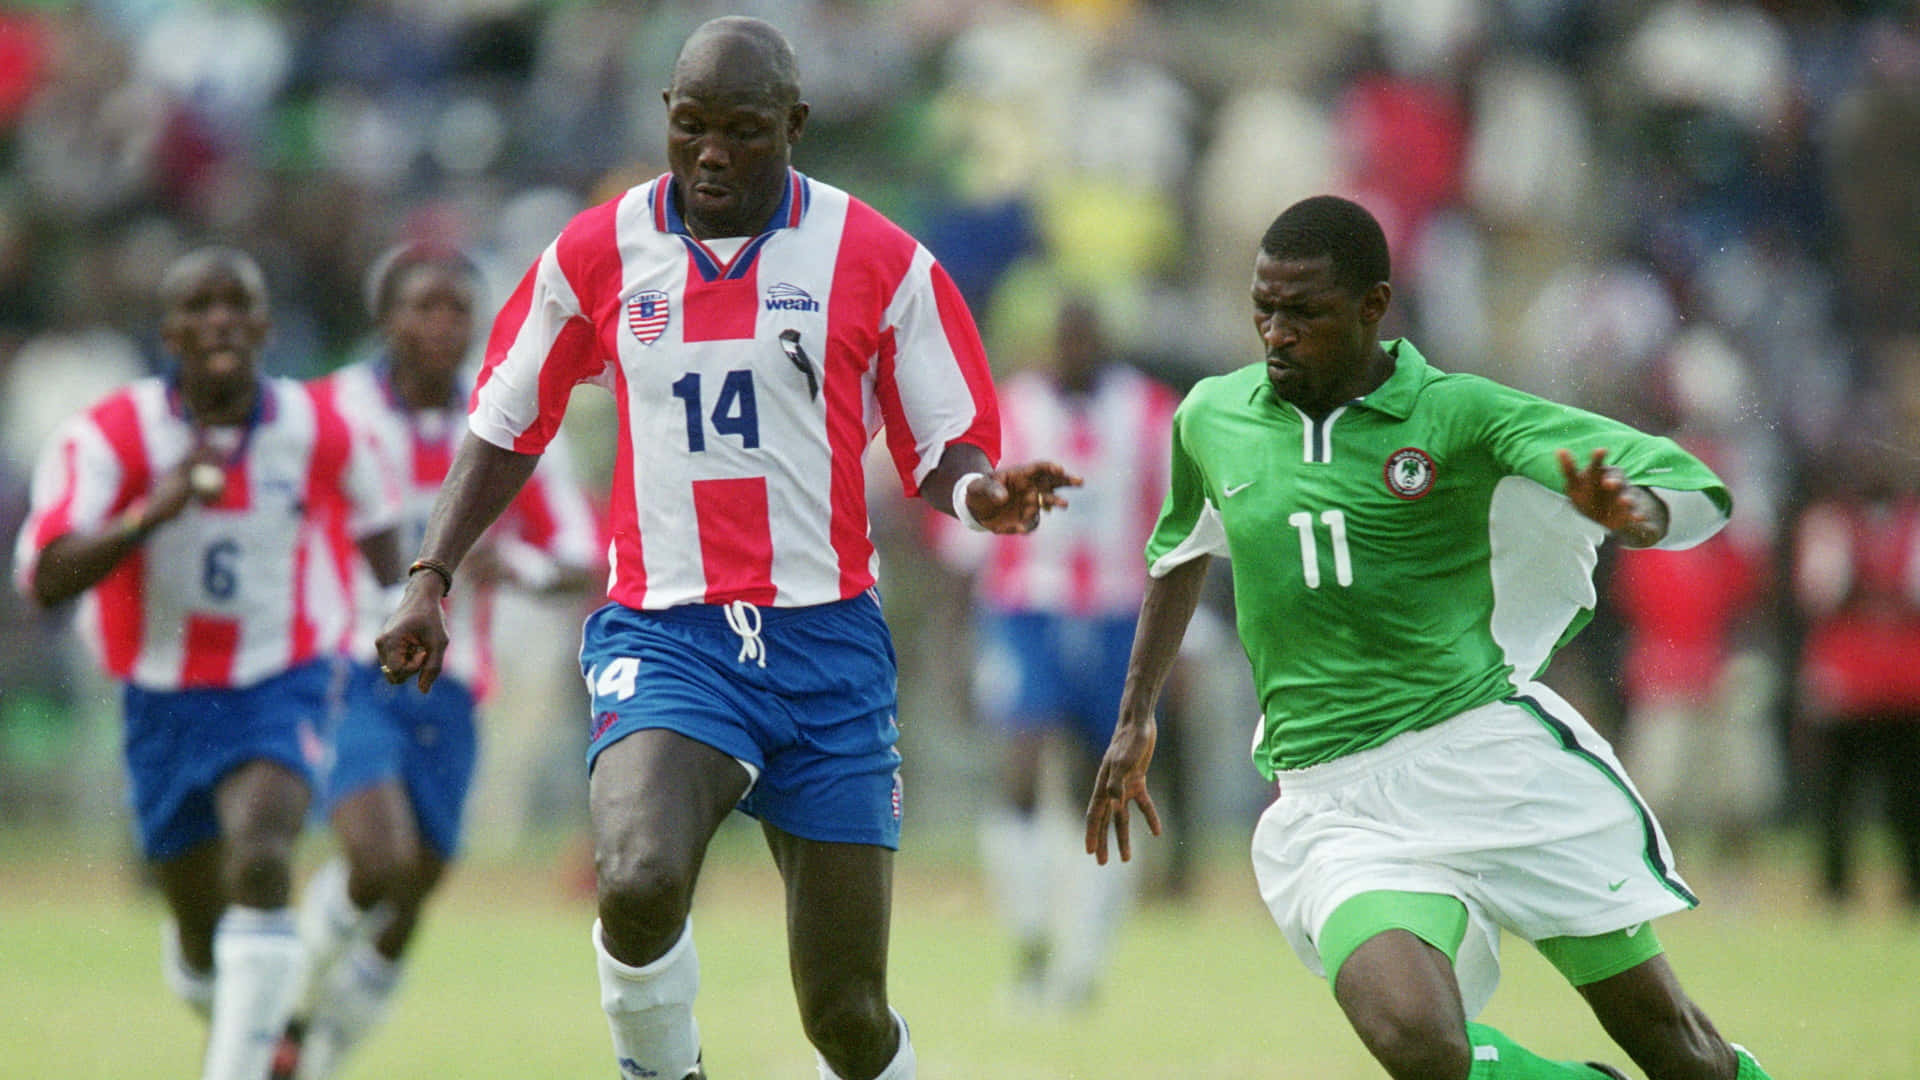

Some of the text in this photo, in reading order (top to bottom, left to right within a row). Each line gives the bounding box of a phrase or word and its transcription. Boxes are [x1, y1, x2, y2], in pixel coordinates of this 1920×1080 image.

[765, 298, 819, 312] weah
[672, 369, 760, 452] 14
[204, 539, 241, 602] 6
[1288, 510, 1353, 588] 11
